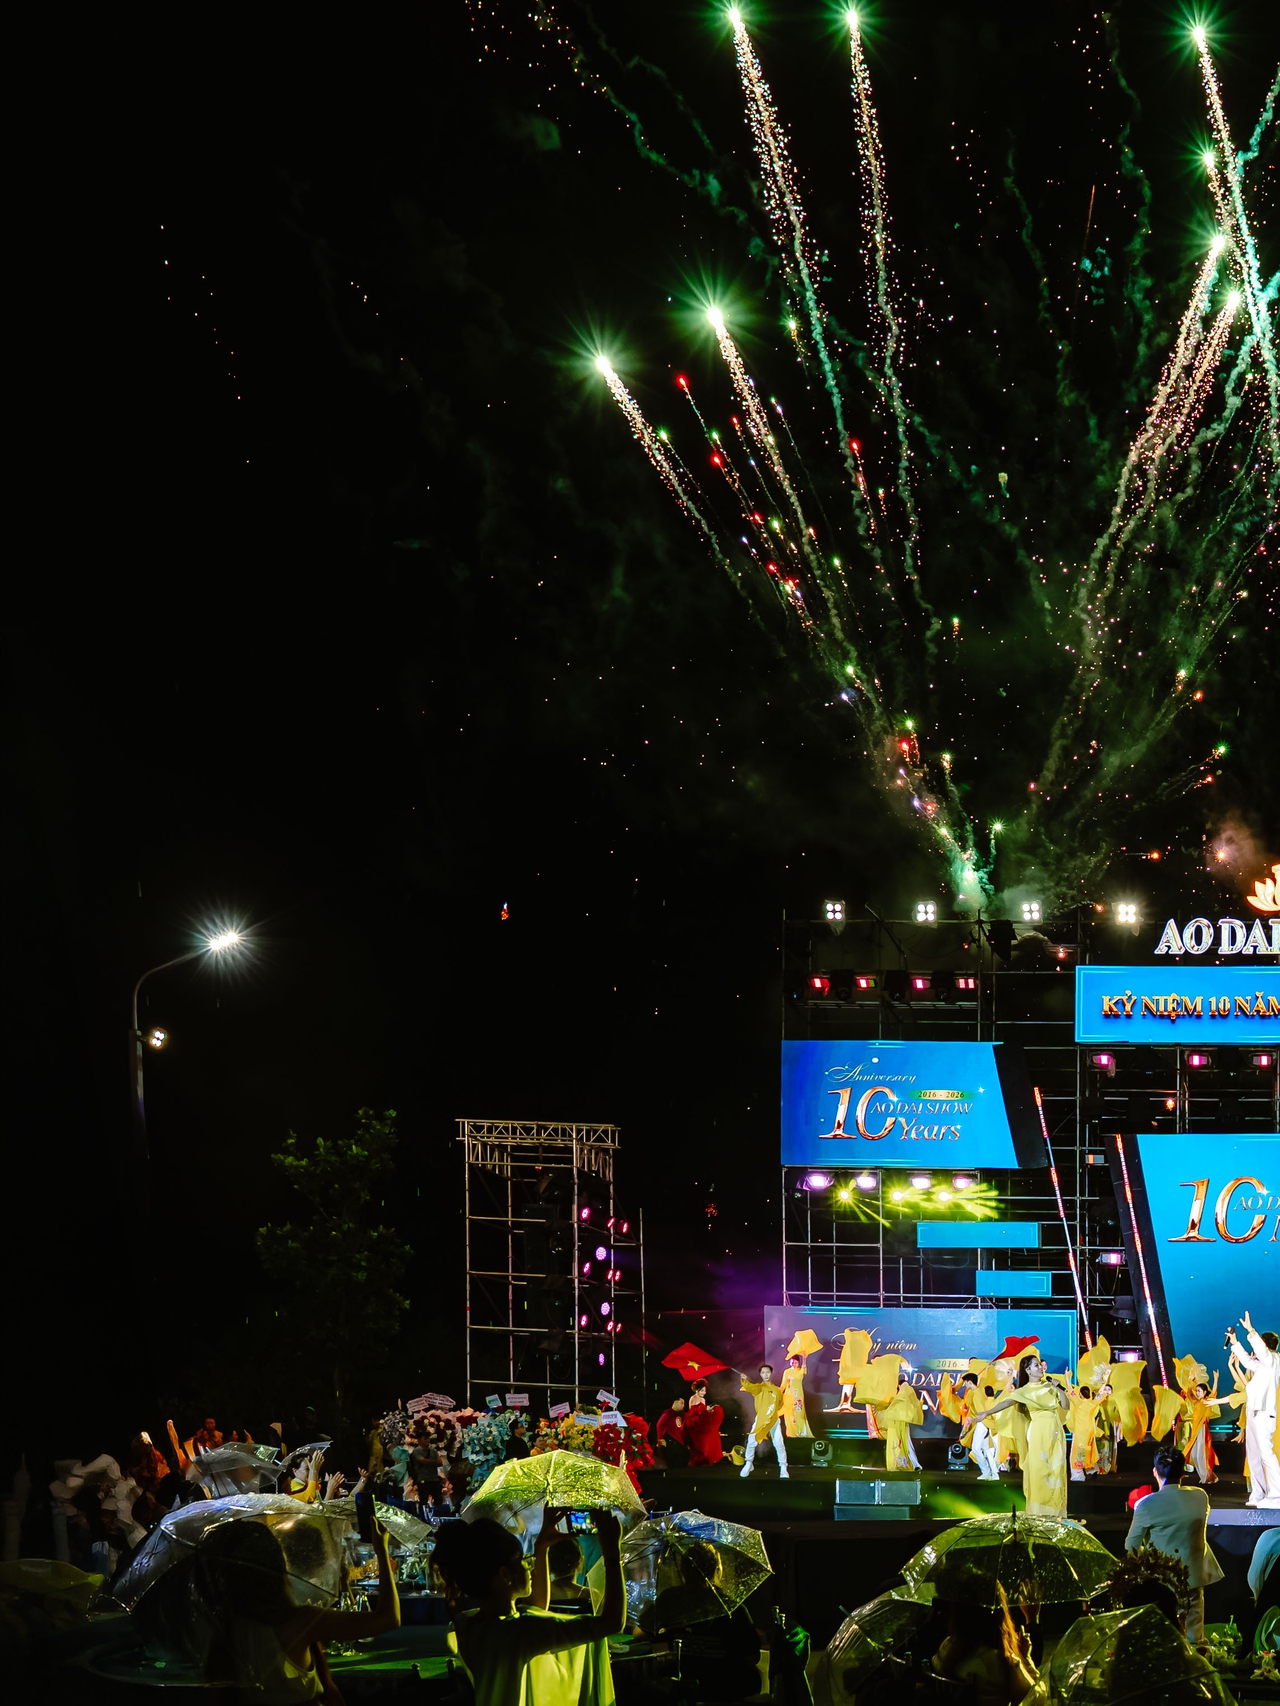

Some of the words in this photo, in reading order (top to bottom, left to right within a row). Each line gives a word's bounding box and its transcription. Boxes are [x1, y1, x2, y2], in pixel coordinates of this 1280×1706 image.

[1154, 918, 1214, 955] AO
[1101, 990, 1137, 1015] KỶ
[1141, 993, 1203, 1020] NIỆM
[1209, 996, 1231, 1015] 10
[825, 1061, 916, 1083] Anniversary
[918, 1090, 937, 1098] 2016
[946, 1090, 965, 1098] 2026
[818, 1086, 897, 1140] 10
[898, 1117, 961, 1141] Years
[870, 1102, 894, 1114] AO
[896, 1102, 923, 1114] DAI
[925, 1102, 973, 1114] SHOW
[1167, 1176, 1267, 1243] 10
[1233, 1195, 1263, 1210] AO
[885, 1339, 917, 1353] niệm
[936, 1360, 958, 1368] 2016
